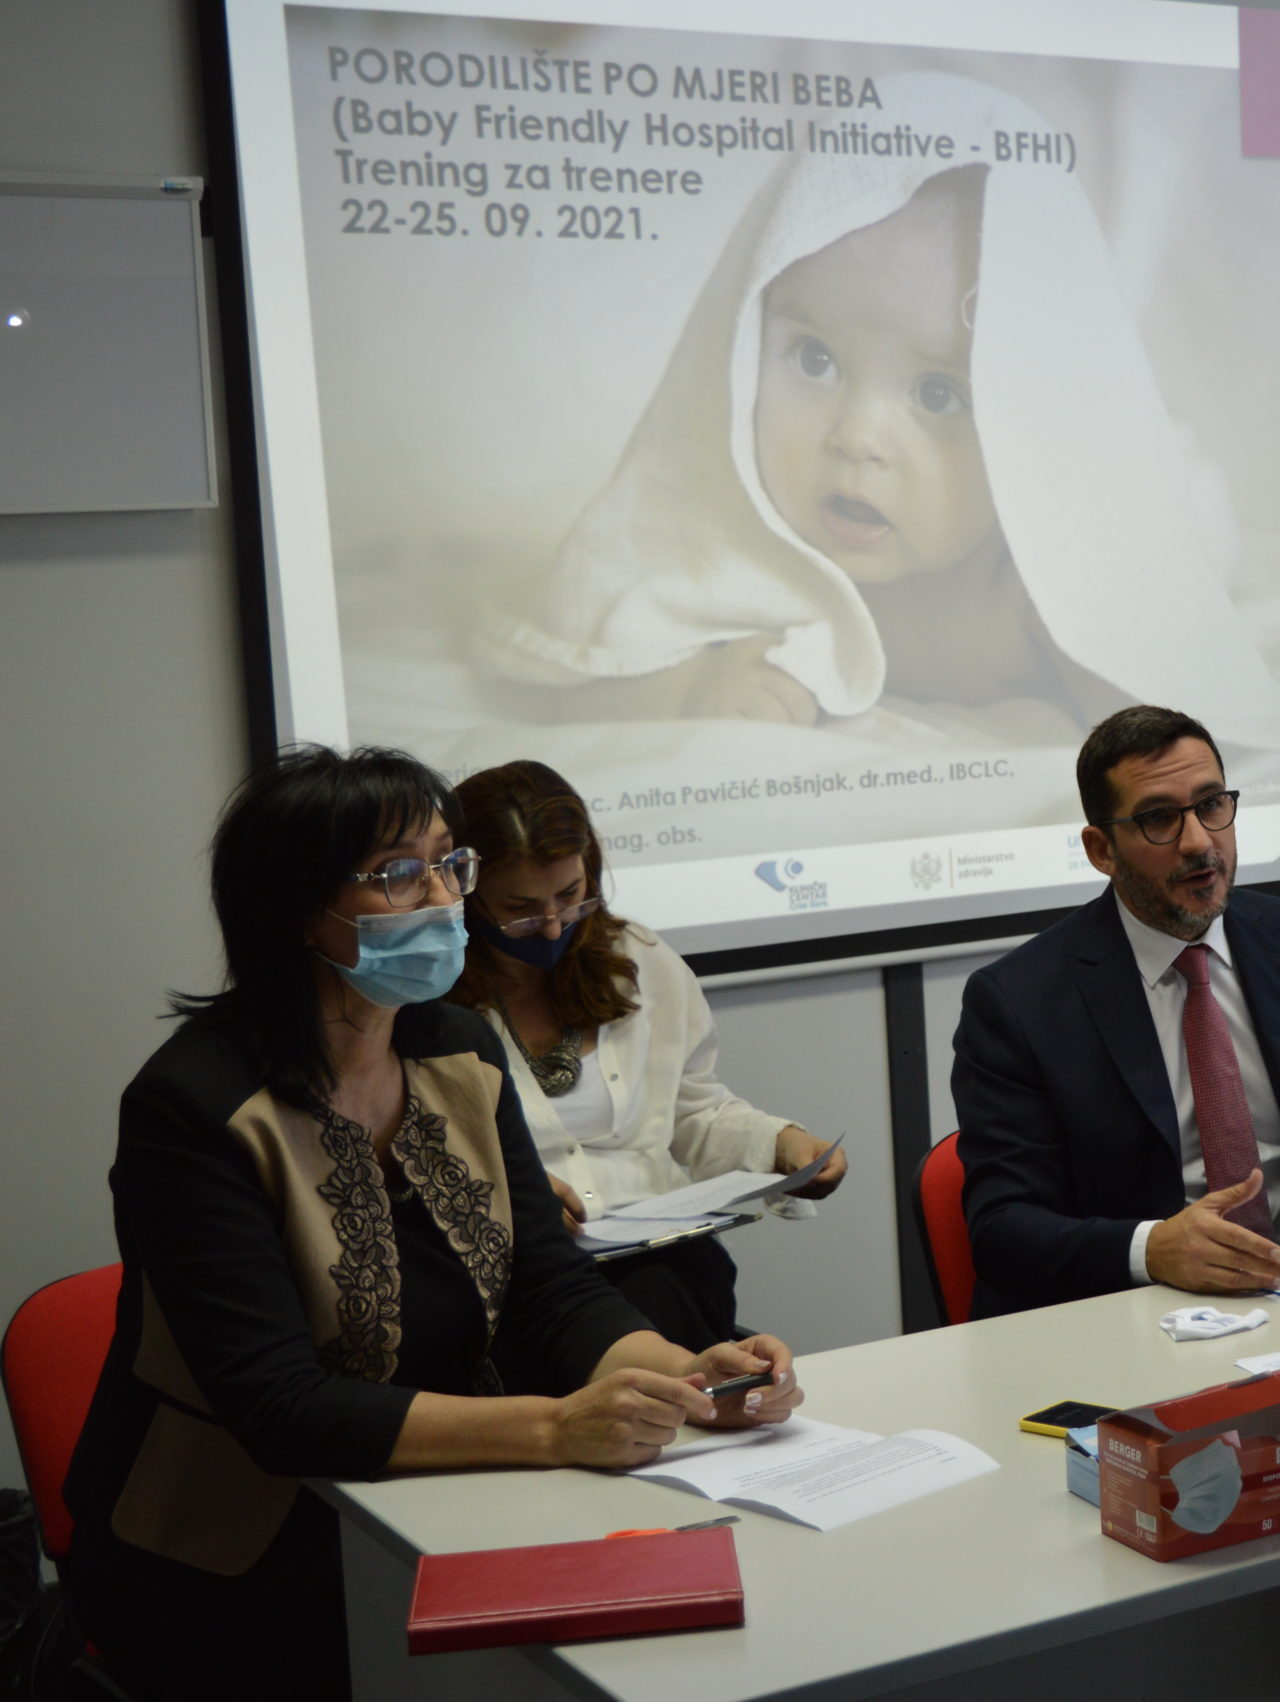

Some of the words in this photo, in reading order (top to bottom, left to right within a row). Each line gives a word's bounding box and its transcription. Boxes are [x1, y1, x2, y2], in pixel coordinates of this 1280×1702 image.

[327, 45, 592, 95] PORODILIŠTE
[603, 60, 659, 98] PO
[673, 66, 780, 105] MJERI
[792, 71, 883, 110] BEBA
[332, 97, 458, 145] (Baby
[475, 103, 628, 152] Friendly
[645, 112, 795, 157] Hospital
[807, 120, 955, 159] Initiative
[994, 131, 1078, 173] BFHI)
[334, 149, 488, 197] Trening
[505, 160, 552, 191] za
[562, 156, 704, 195] trenere
[340, 200, 469, 237] 22-25.
[484, 202, 544, 238] 09.
[556, 206, 659, 241] 2021.
[618, 787, 676, 811] Anita
[682, 778, 760, 806] Pavičić
[766, 772, 854, 798] Bošnjak,
[859, 764, 945, 790] dr.med.,
[949, 760, 1015, 782] IBCLC,
[657, 826, 702, 846] obs.
[957, 852, 1015, 866] Ministarstvo
[1109, 1438, 1142, 1464] BERGER
